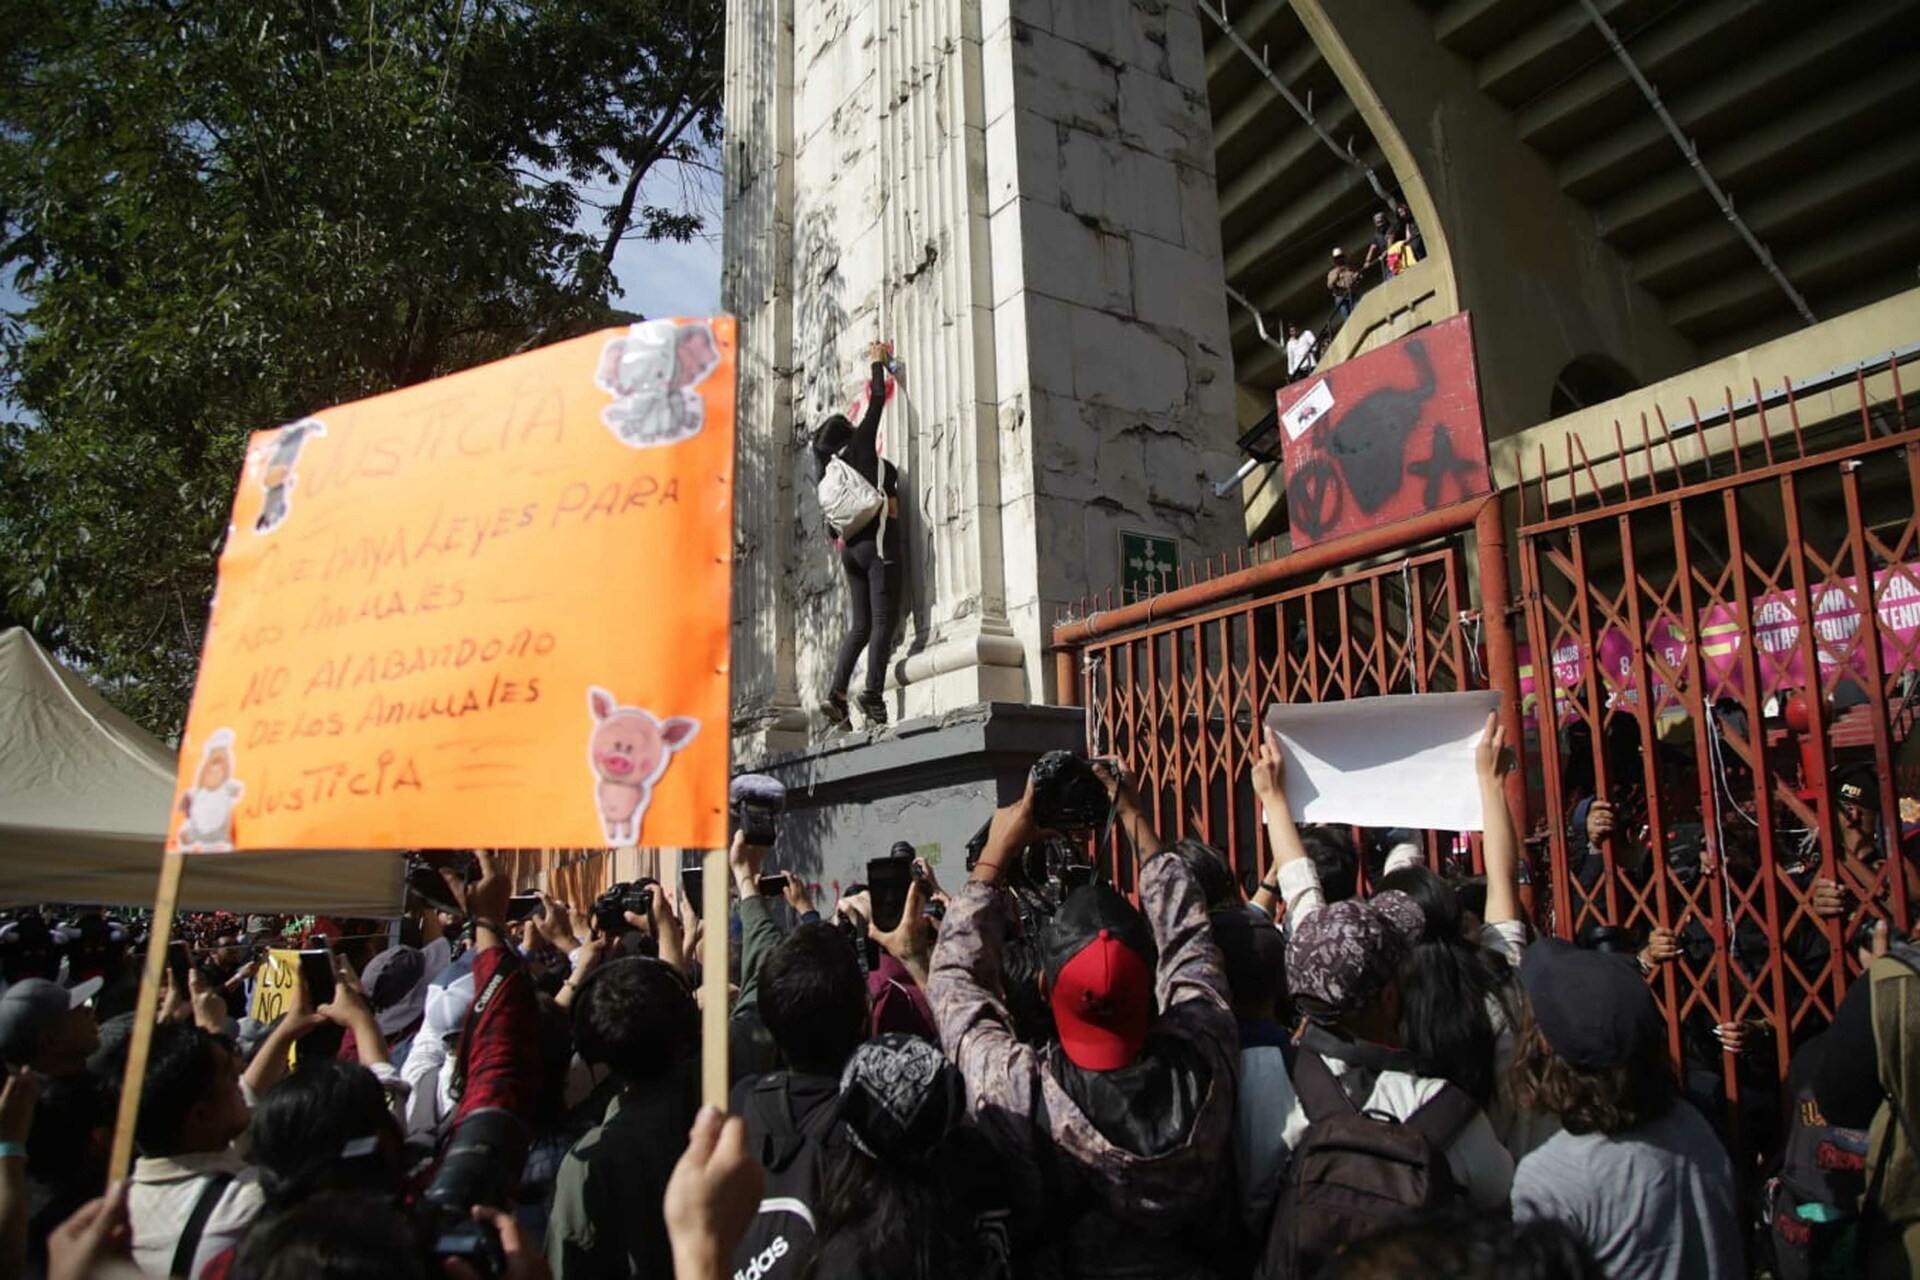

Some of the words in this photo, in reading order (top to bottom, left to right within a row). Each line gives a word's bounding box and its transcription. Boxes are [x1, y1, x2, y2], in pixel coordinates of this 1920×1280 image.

[552, 475, 680, 530] PARA
[240, 666, 290, 711] NO
[256, 992, 283, 1024] NO
